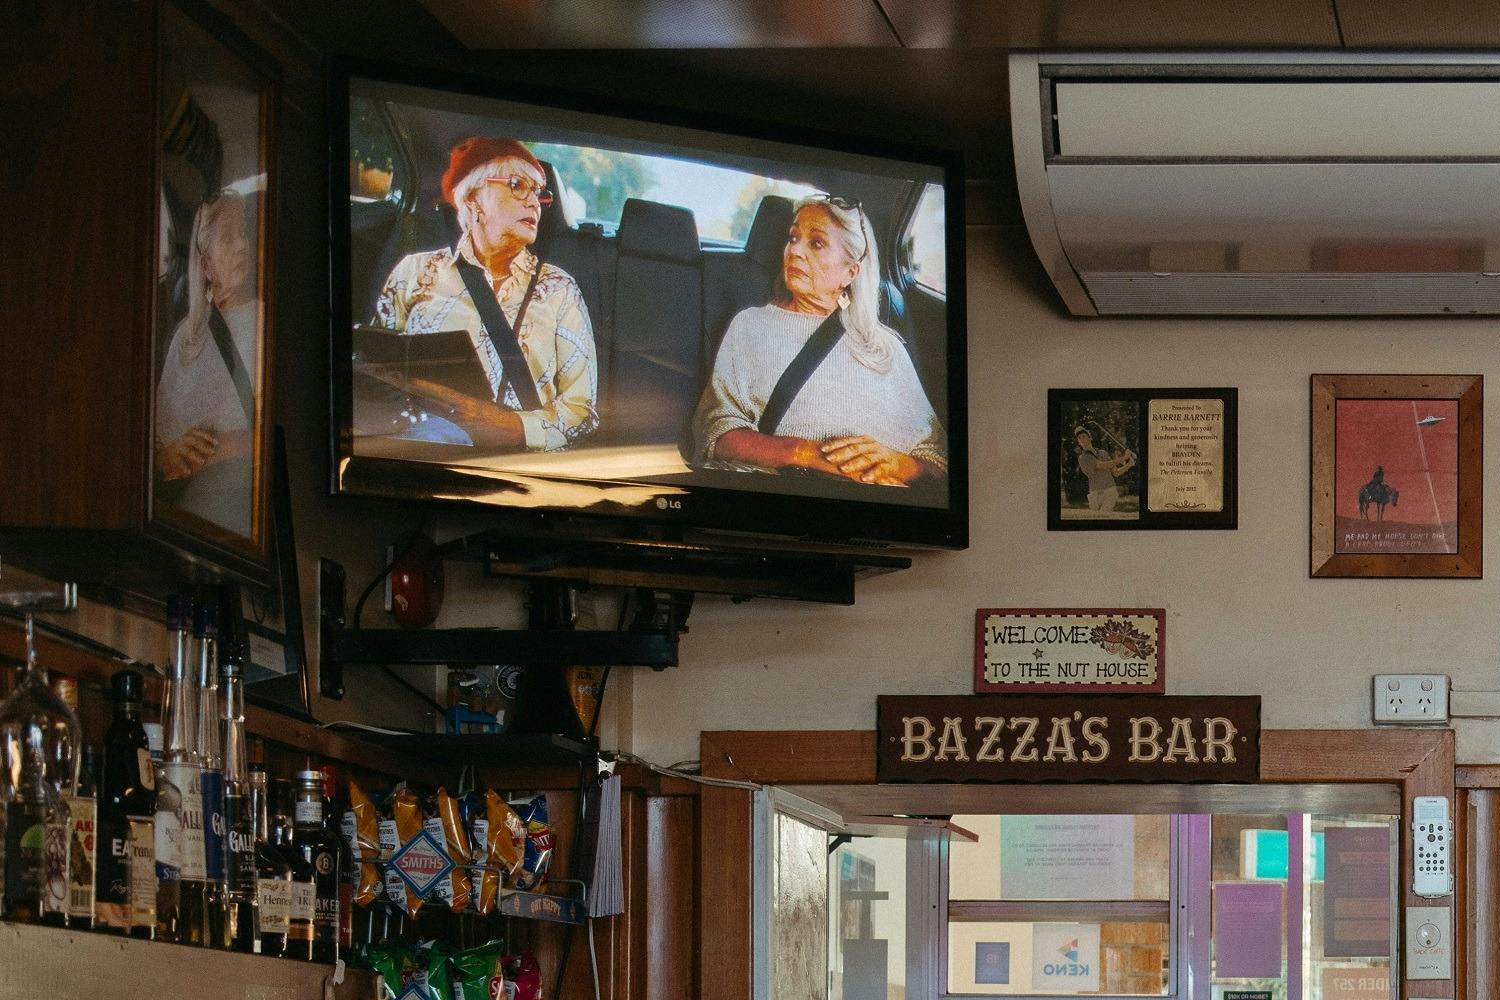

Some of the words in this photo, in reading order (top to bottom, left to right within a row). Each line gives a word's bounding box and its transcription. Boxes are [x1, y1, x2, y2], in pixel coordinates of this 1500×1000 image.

[1152, 413, 1182, 421] BARRIE
[1184, 413, 1221, 421] BARNETT
[669, 500, 681, 509] LG
[991, 625, 1090, 645] WELCOME
[991, 662, 1011, 678] TO
[1018, 662, 1050, 678] THE
[1057, 662, 1090, 678] NUT
[1096, 662, 1149, 678] HOUSE
[900, 711, 1111, 763] BAZZA'S
[1128, 716, 1238, 764] BAR
[401, 856, 445, 869] SMITHS
